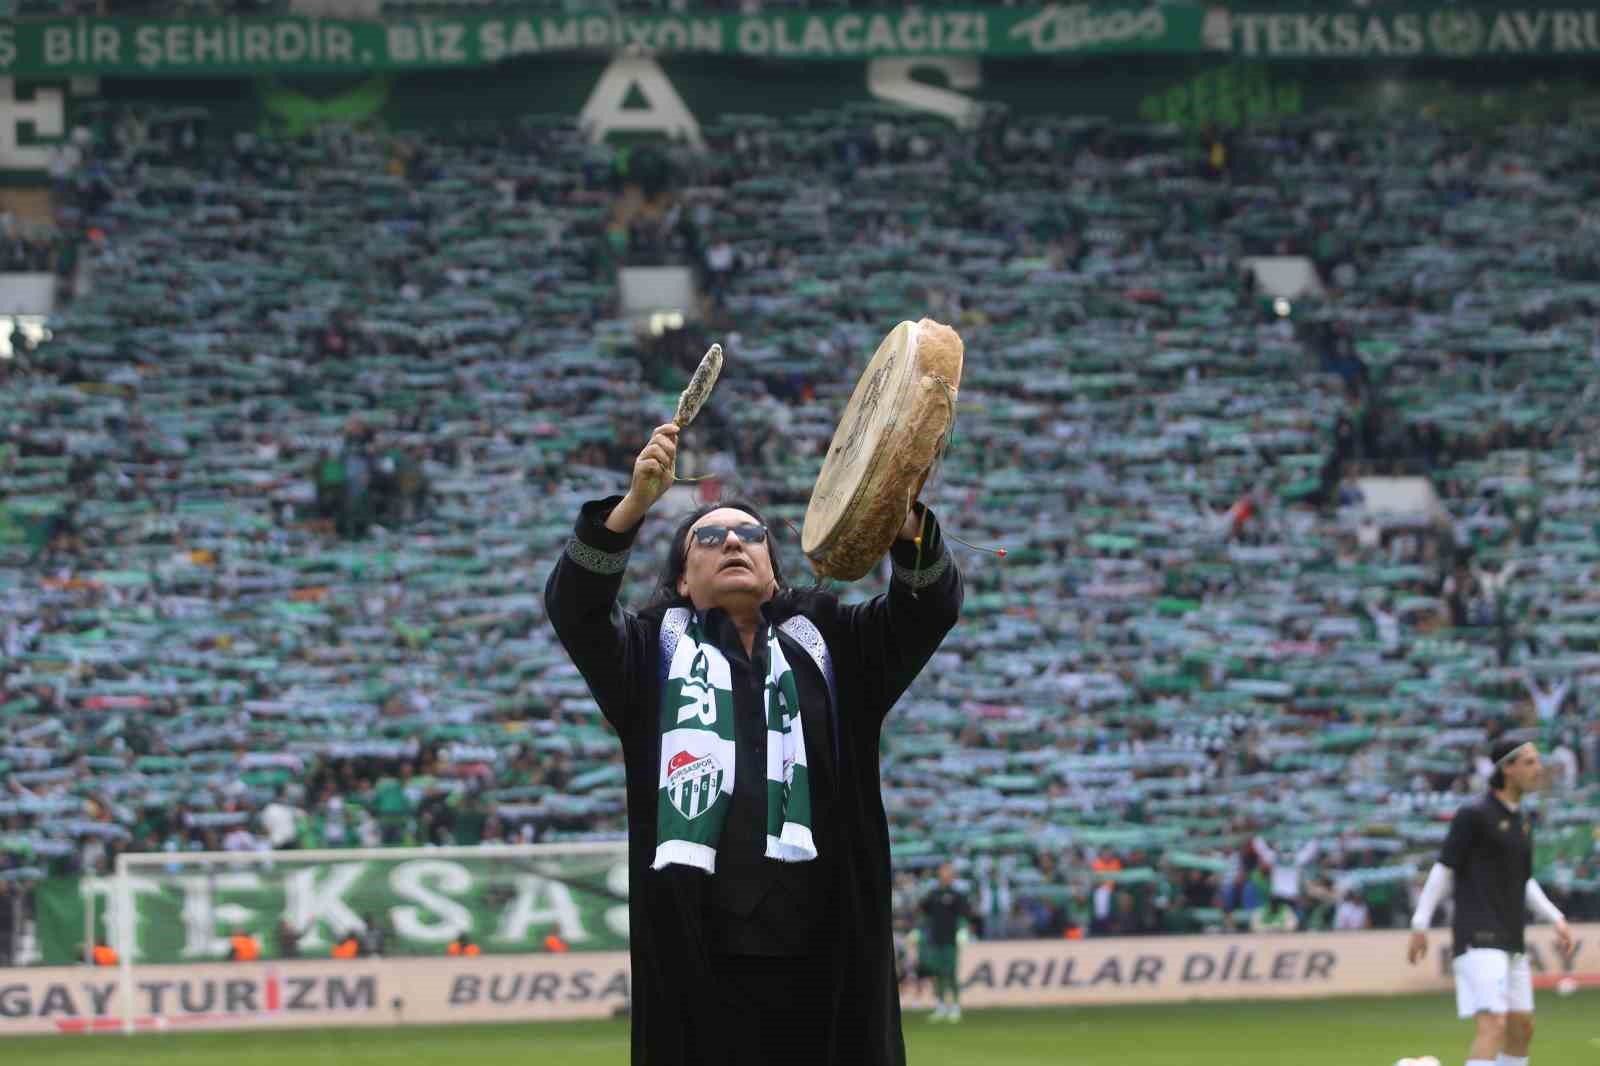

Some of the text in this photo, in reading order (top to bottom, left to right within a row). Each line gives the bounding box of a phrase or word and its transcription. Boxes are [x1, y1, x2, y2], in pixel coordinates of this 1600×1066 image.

[44, 20, 121, 63] BİR
[387, 21, 465, 61] BİZ
[738, 10, 989, 54] OLACAĞIZ!
[1226, 12, 1423, 55] TEKSAS
[684, 778, 716, 797] 1963
[80, 858, 629, 961] TEKSA
[1183, 942, 1338, 983] DİLER
[0, 967, 377, 1017] GAY TURİZM
